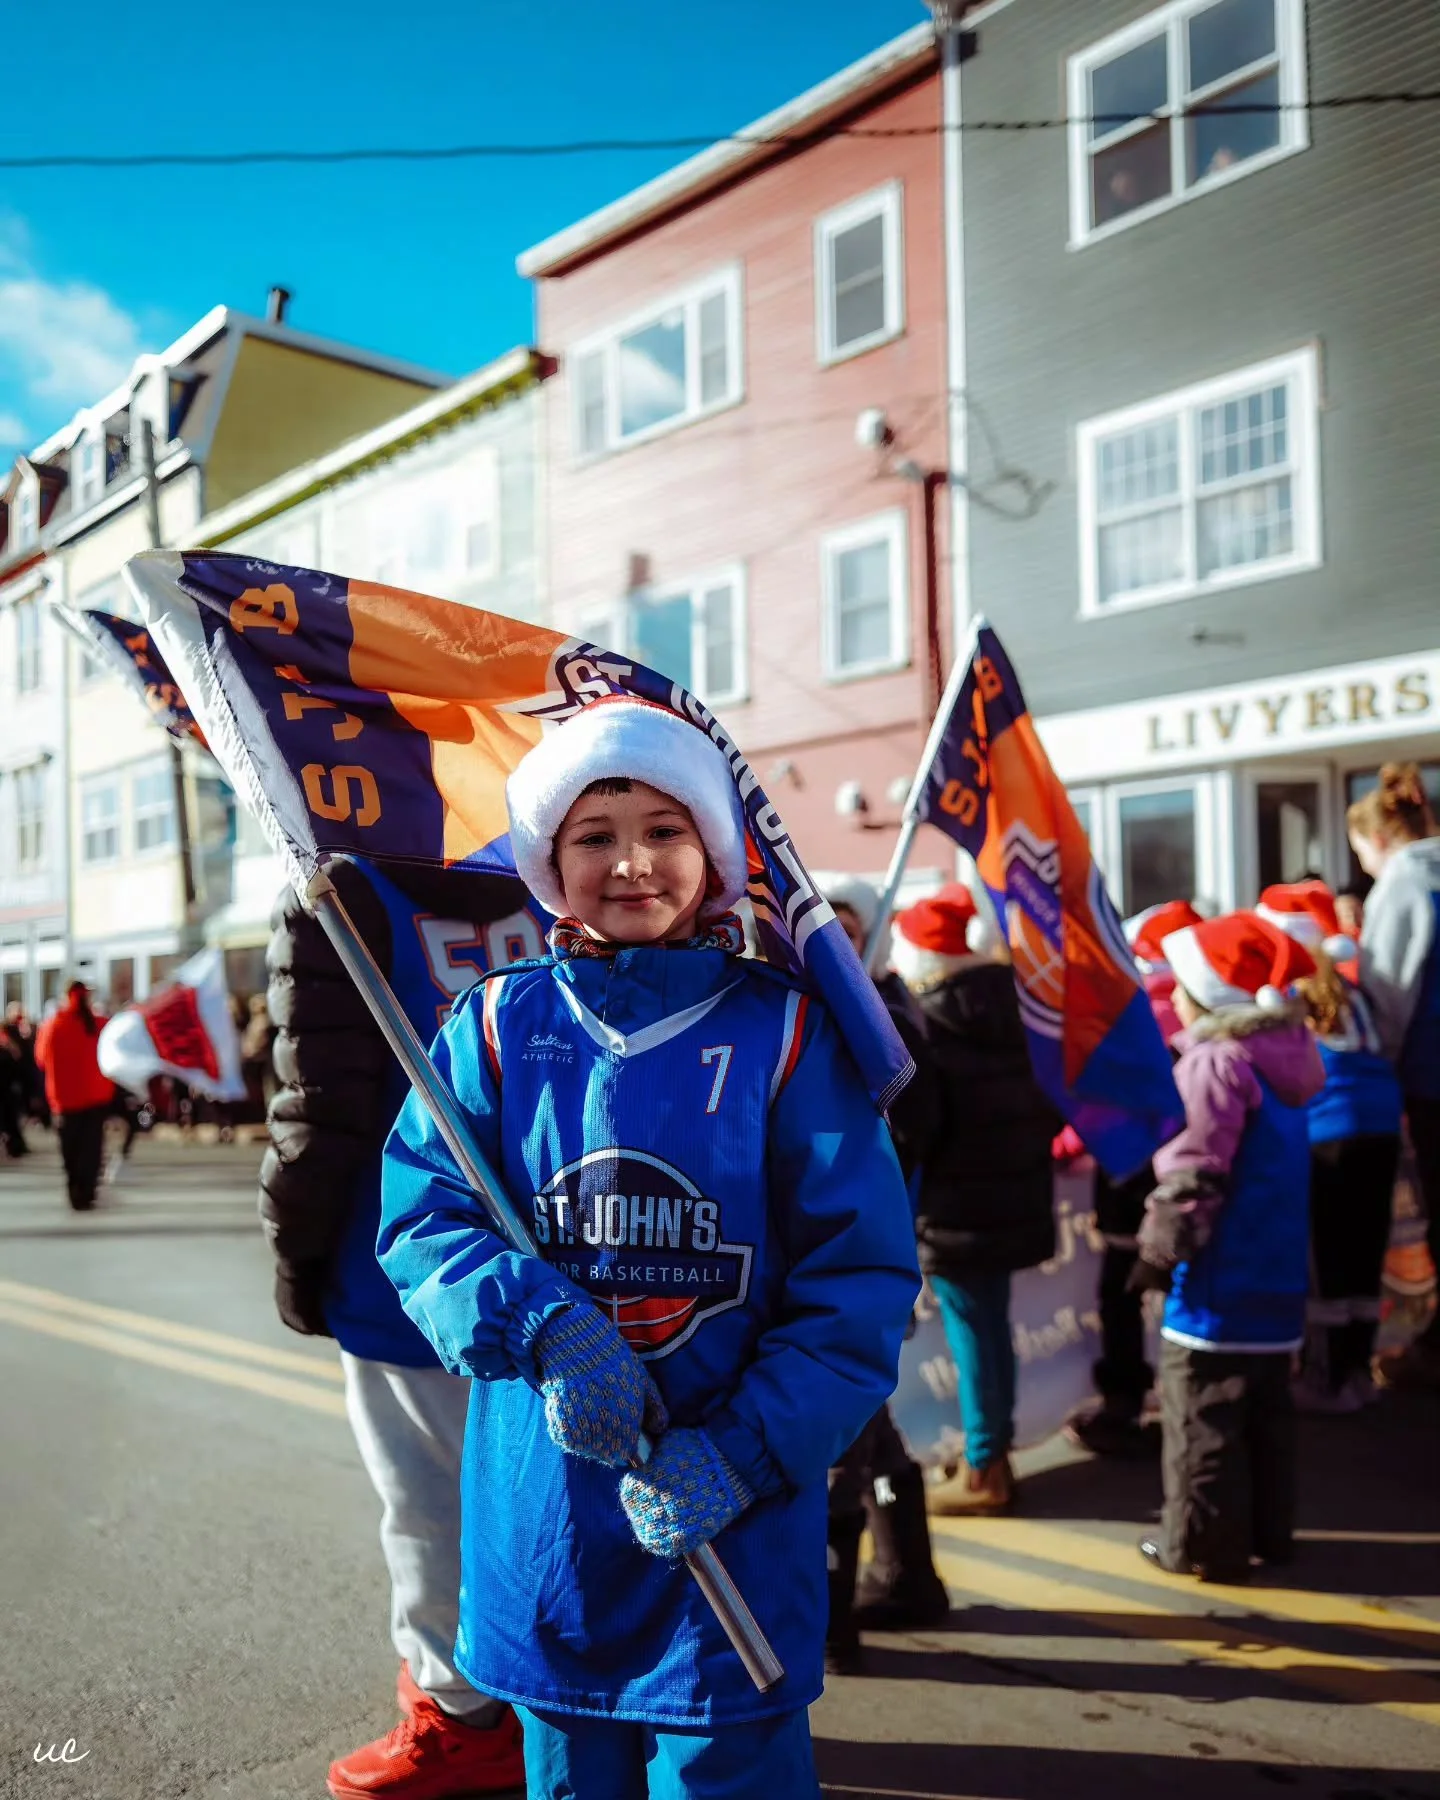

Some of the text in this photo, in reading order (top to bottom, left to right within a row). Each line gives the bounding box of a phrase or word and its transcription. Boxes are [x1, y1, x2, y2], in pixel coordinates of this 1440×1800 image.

[1147, 671, 1432, 750] LIVYERS
[521, 1052, 575, 1064] ATHLETIC
[701, 1045, 734, 1114] 7
[532, 1194, 718, 1251] ST. JOHN'S
[589, 1264, 726, 1283] BASKETBALL
